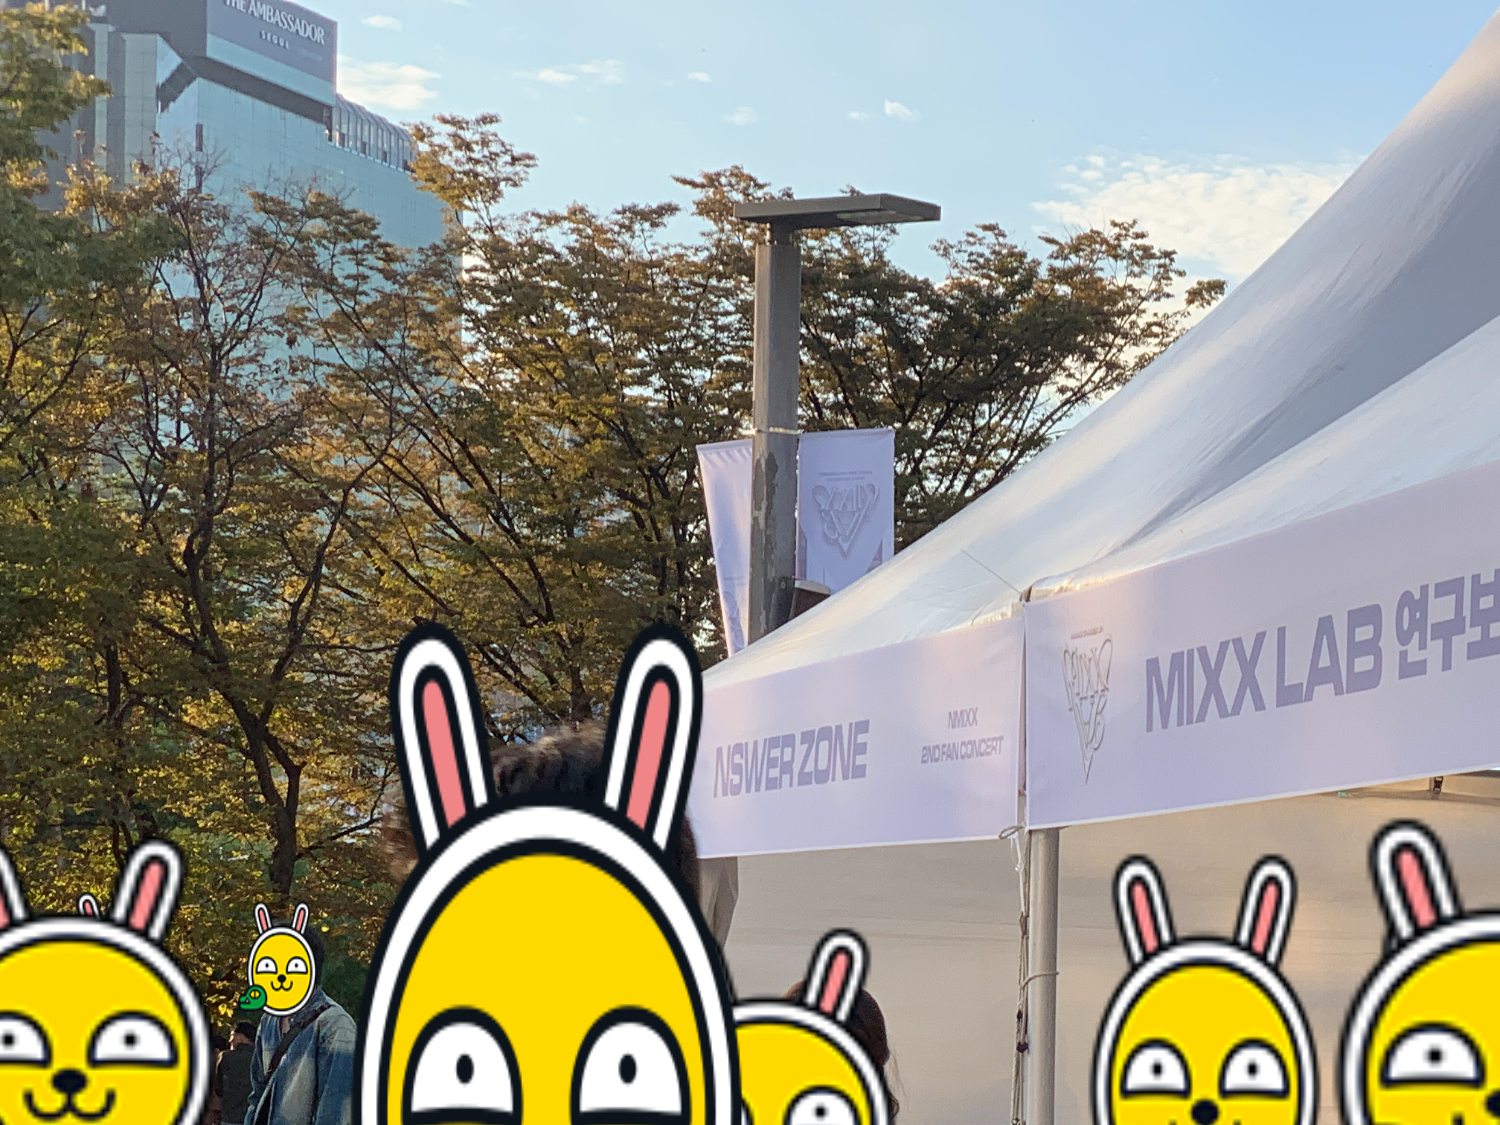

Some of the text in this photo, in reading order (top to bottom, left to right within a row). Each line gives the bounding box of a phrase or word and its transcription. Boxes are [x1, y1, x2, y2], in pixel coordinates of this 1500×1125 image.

[248, 0, 325, 45] AMBASSADOR
[261, 30, 289, 49] SEOUL
[1146, 630, 1267, 733] MIXX
[1276, 604, 1383, 708] LAB
[948, 707, 978, 730] NMIXX
[713, 719, 870, 798] NSWER ZONE
[920, 736, 1004, 764] 2ND FAN CONCERT
